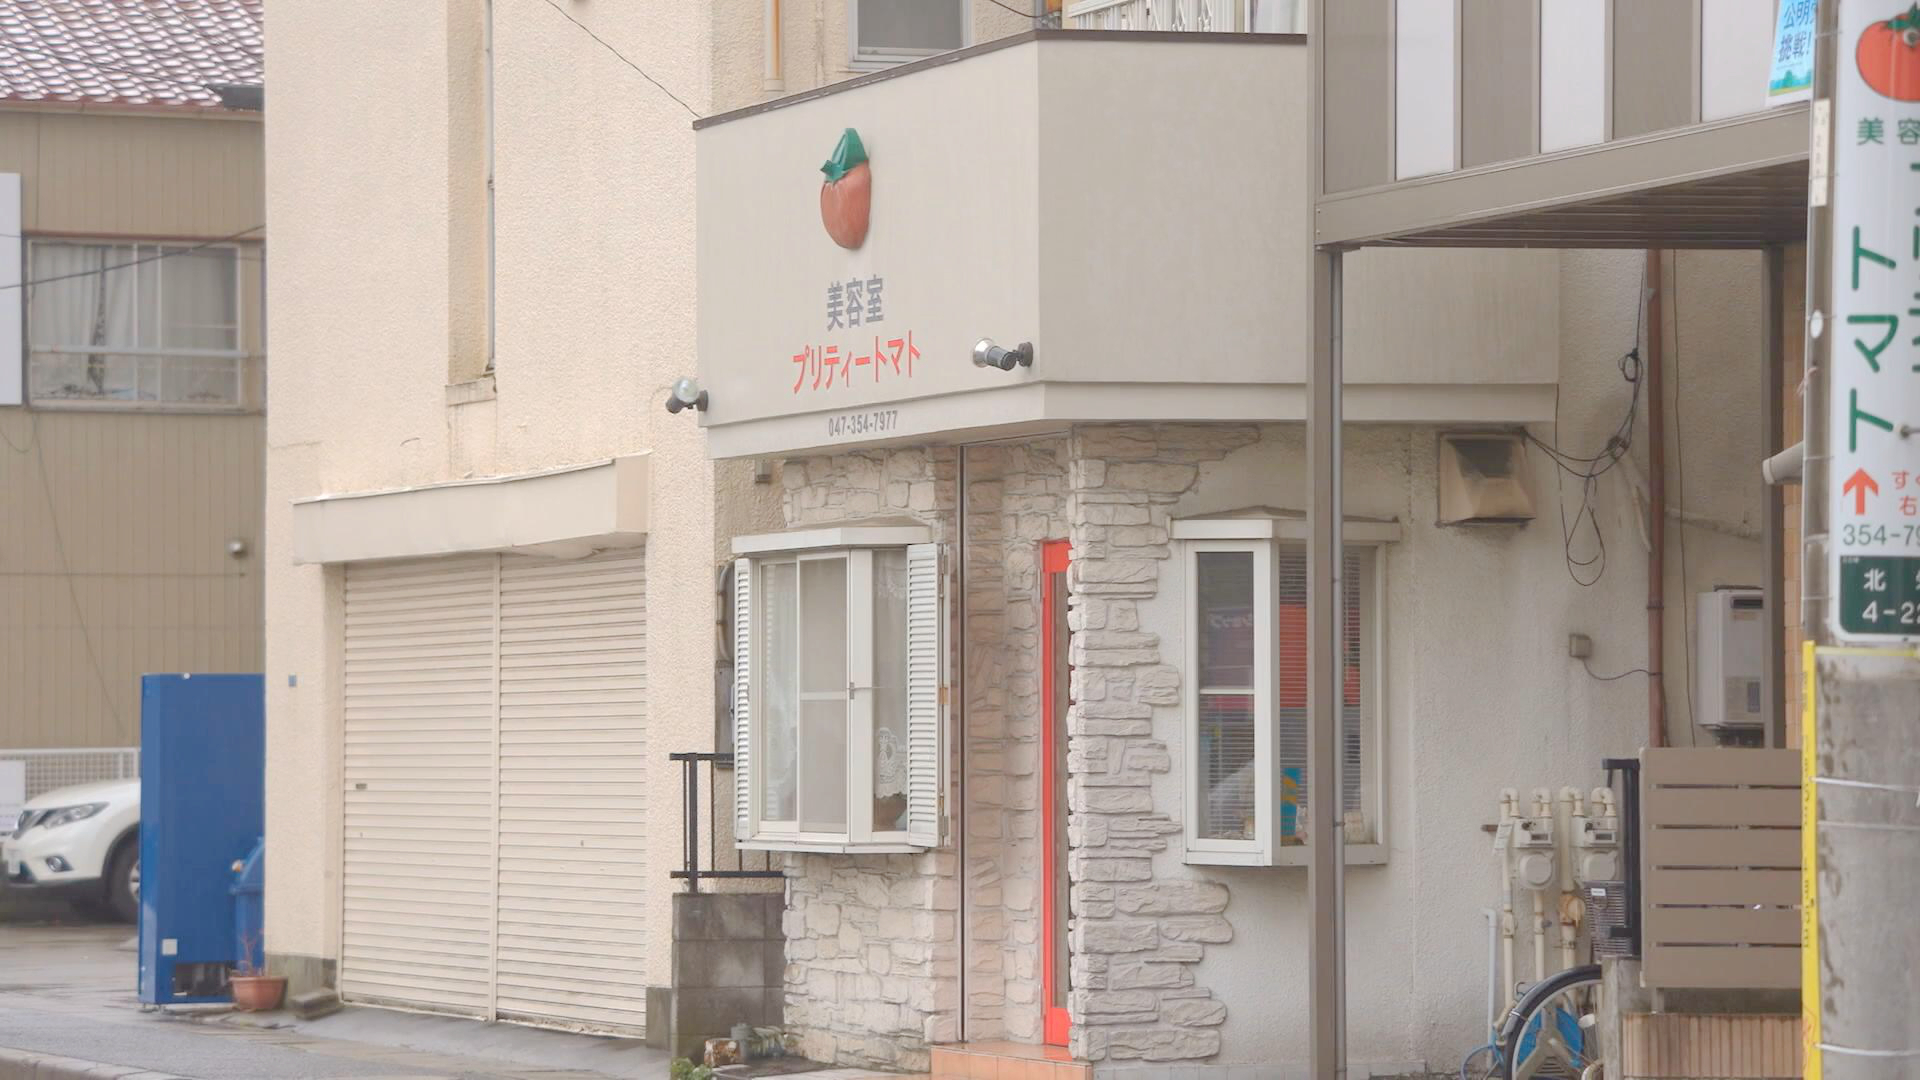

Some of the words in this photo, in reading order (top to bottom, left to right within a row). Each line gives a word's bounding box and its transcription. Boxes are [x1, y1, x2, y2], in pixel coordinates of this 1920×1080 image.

[826, 274, 884, 332] 美容室
[792, 329, 921, 394] プリティートマト
[1848, 225, 1898, 453] トマト
[828, 410, 898, 437] 047-354-7977
[1862, 600, 1920, 624] 4-2
